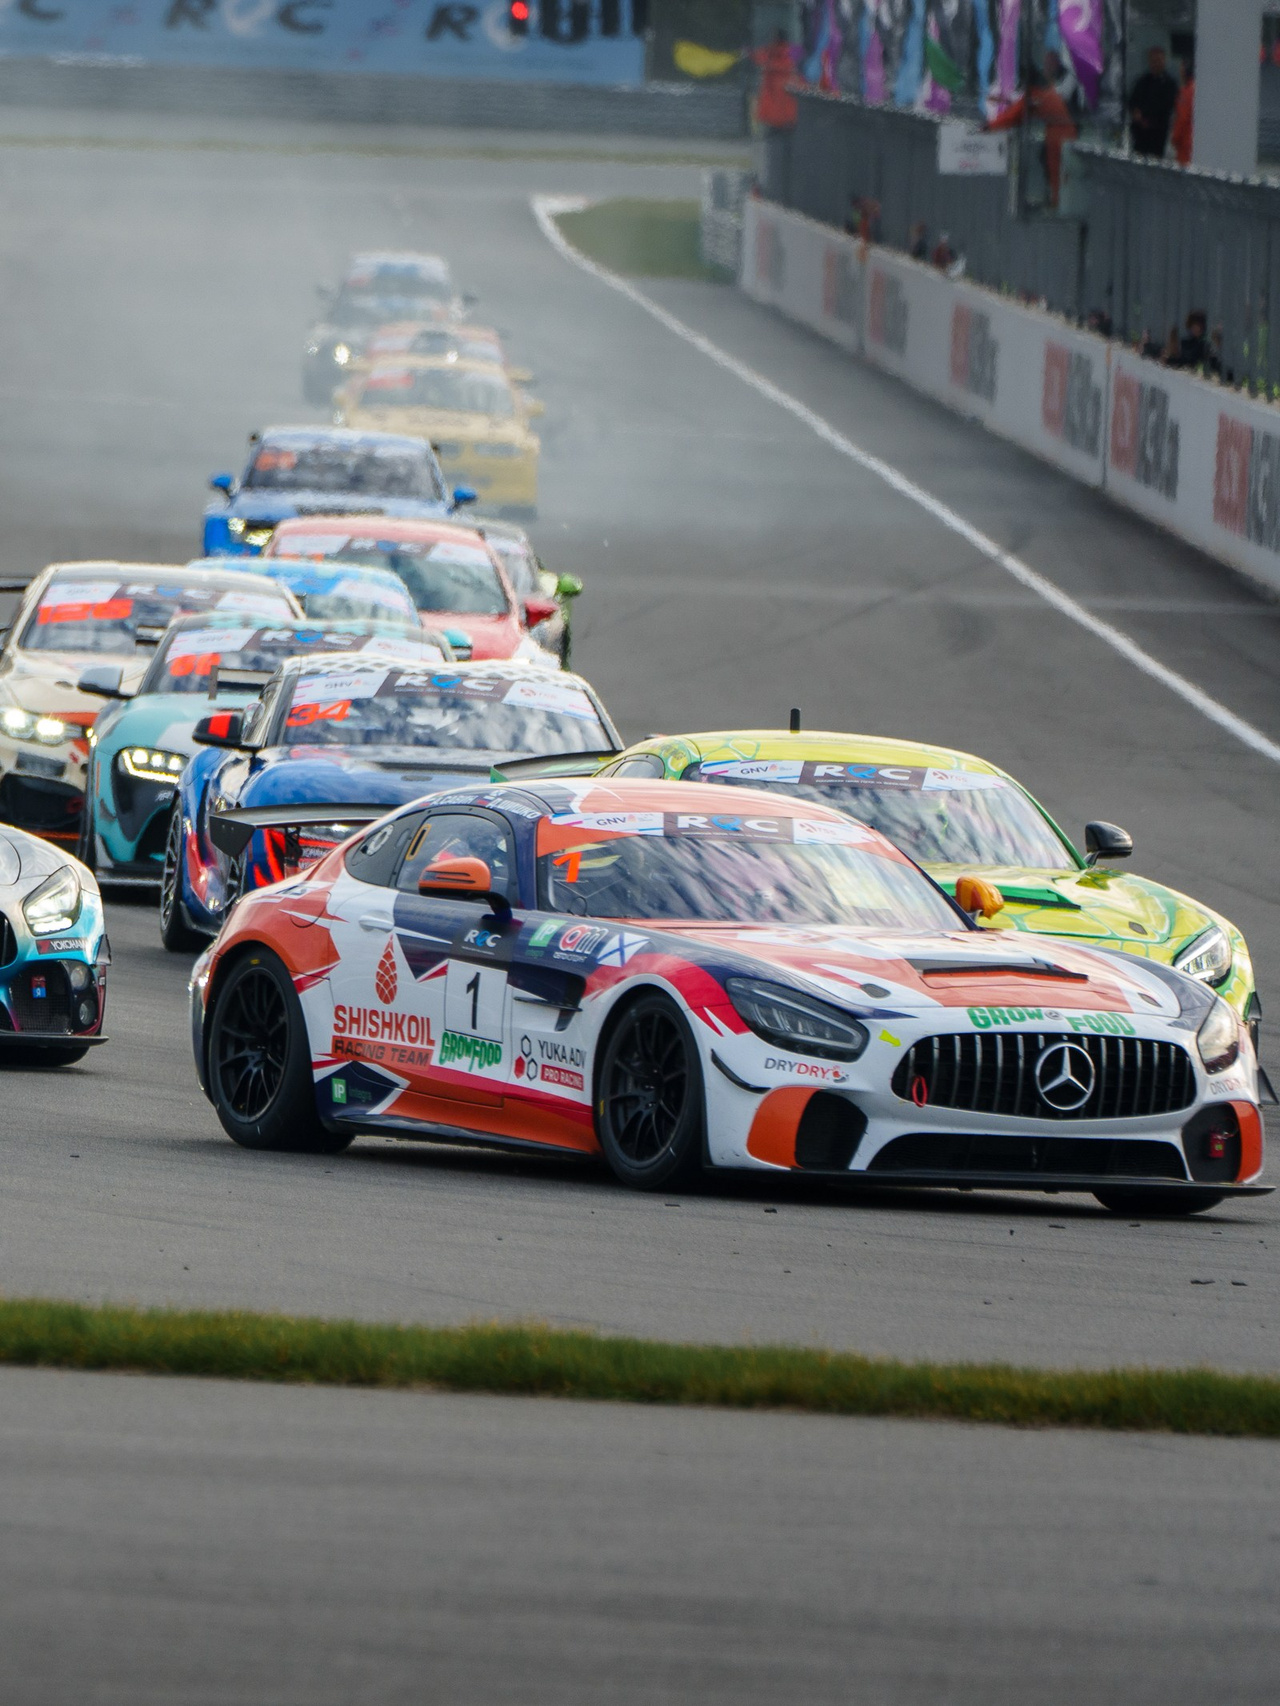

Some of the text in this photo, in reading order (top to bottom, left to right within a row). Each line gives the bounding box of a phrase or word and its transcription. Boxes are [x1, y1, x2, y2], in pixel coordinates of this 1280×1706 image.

[286, 699, 352, 727] 34
[740, 765, 769, 776] GNV
[596, 815, 627, 827] GNV
[552, 851, 582, 883] 1
[466, 971, 481, 1031] 1
[333, 1004, 436, 1047] SHISHKOIL
[967, 1006, 1136, 1036] GROW FOOD
[334, 1038, 430, 1067] RACING TEAM
[538, 1039, 568, 1063] YUKA
[544, 1067, 583, 1089] PRO RACING
[764, 1057, 829, 1081] DRYDRY
